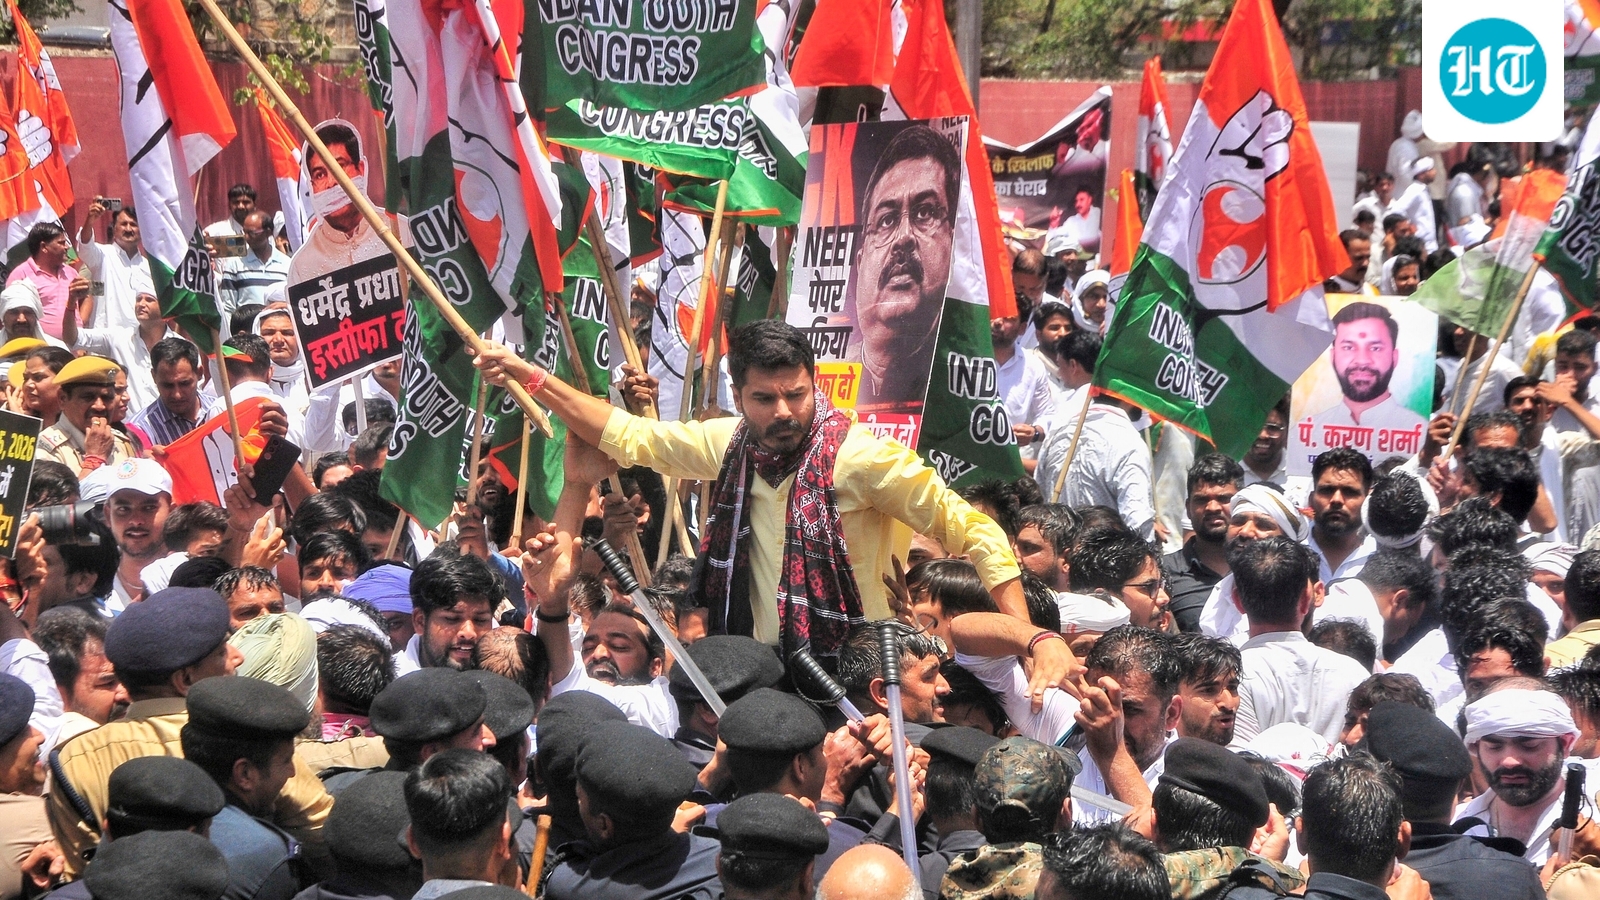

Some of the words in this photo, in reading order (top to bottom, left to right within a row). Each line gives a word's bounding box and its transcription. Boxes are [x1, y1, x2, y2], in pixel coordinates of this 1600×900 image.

[556, 24, 701, 85] CONGRESS
[803, 225, 863, 268] NEET
[354, 266, 401, 309] प्रधा
[808, 269, 846, 313] पेपर
[307, 317, 389, 381] इस्तीफा
[837, 365, 857, 401] दो
[7, 432, 36, 462] 2026
[1323, 424, 1374, 451] करण
[1377, 423, 1423, 454] शर्मा
